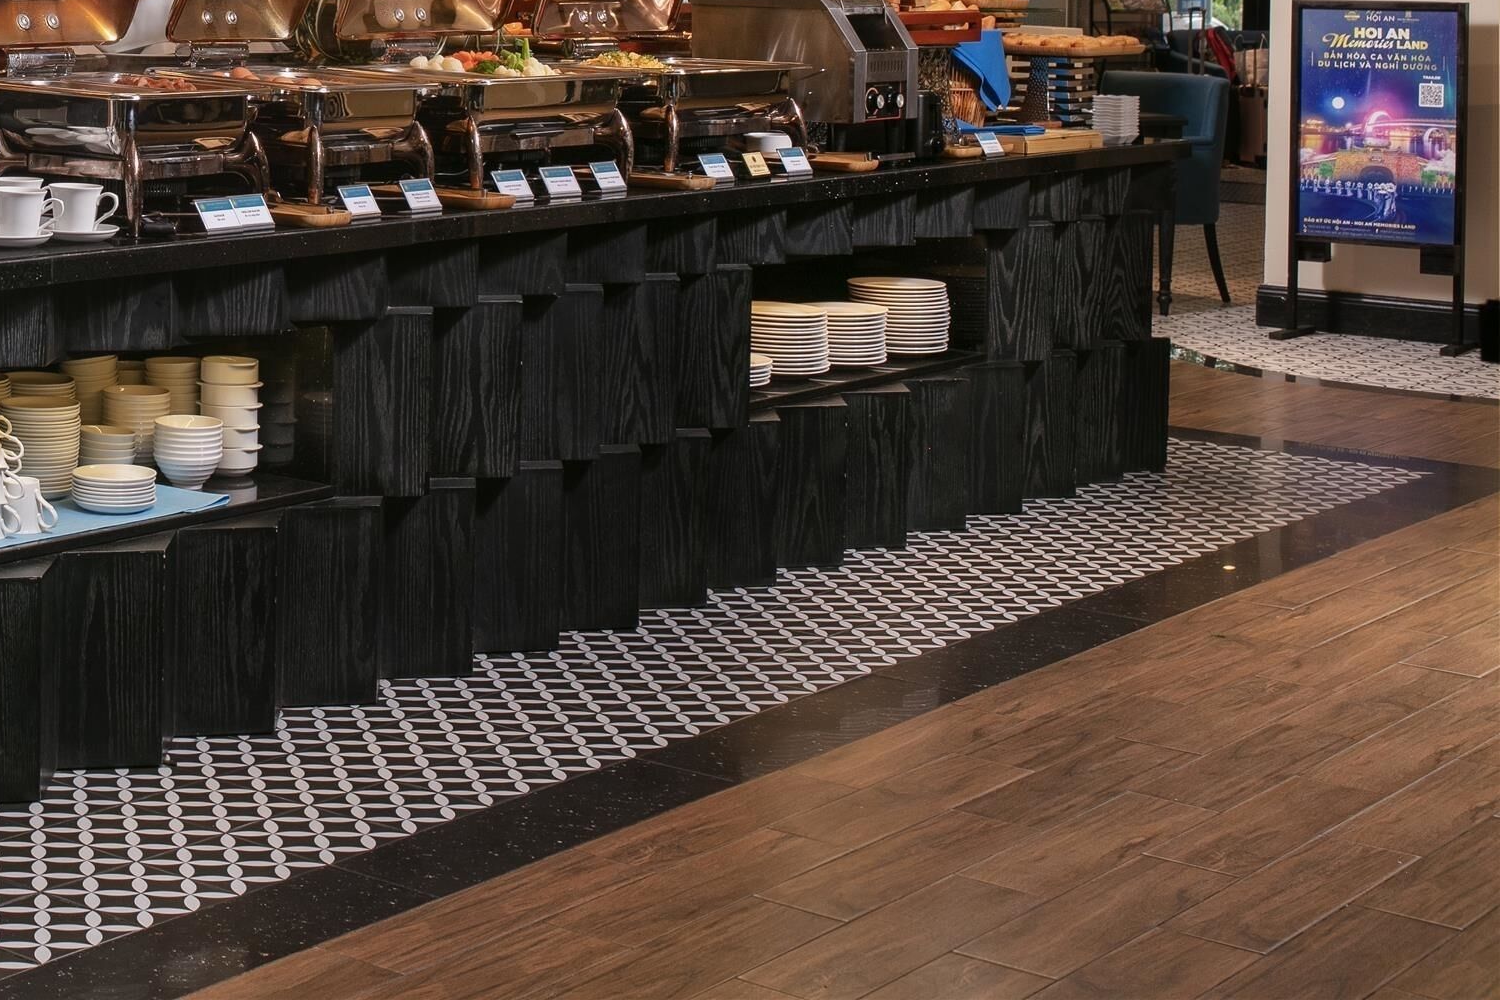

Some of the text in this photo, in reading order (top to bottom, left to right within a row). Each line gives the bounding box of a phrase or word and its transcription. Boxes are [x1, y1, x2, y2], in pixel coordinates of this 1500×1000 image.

[1386, 28, 1410, 40] AN
[1322, 33, 1428, 50] Memories LAND
[1370, 53, 1384, 61] CA
[1334, 61, 1356, 69] LỊCH
